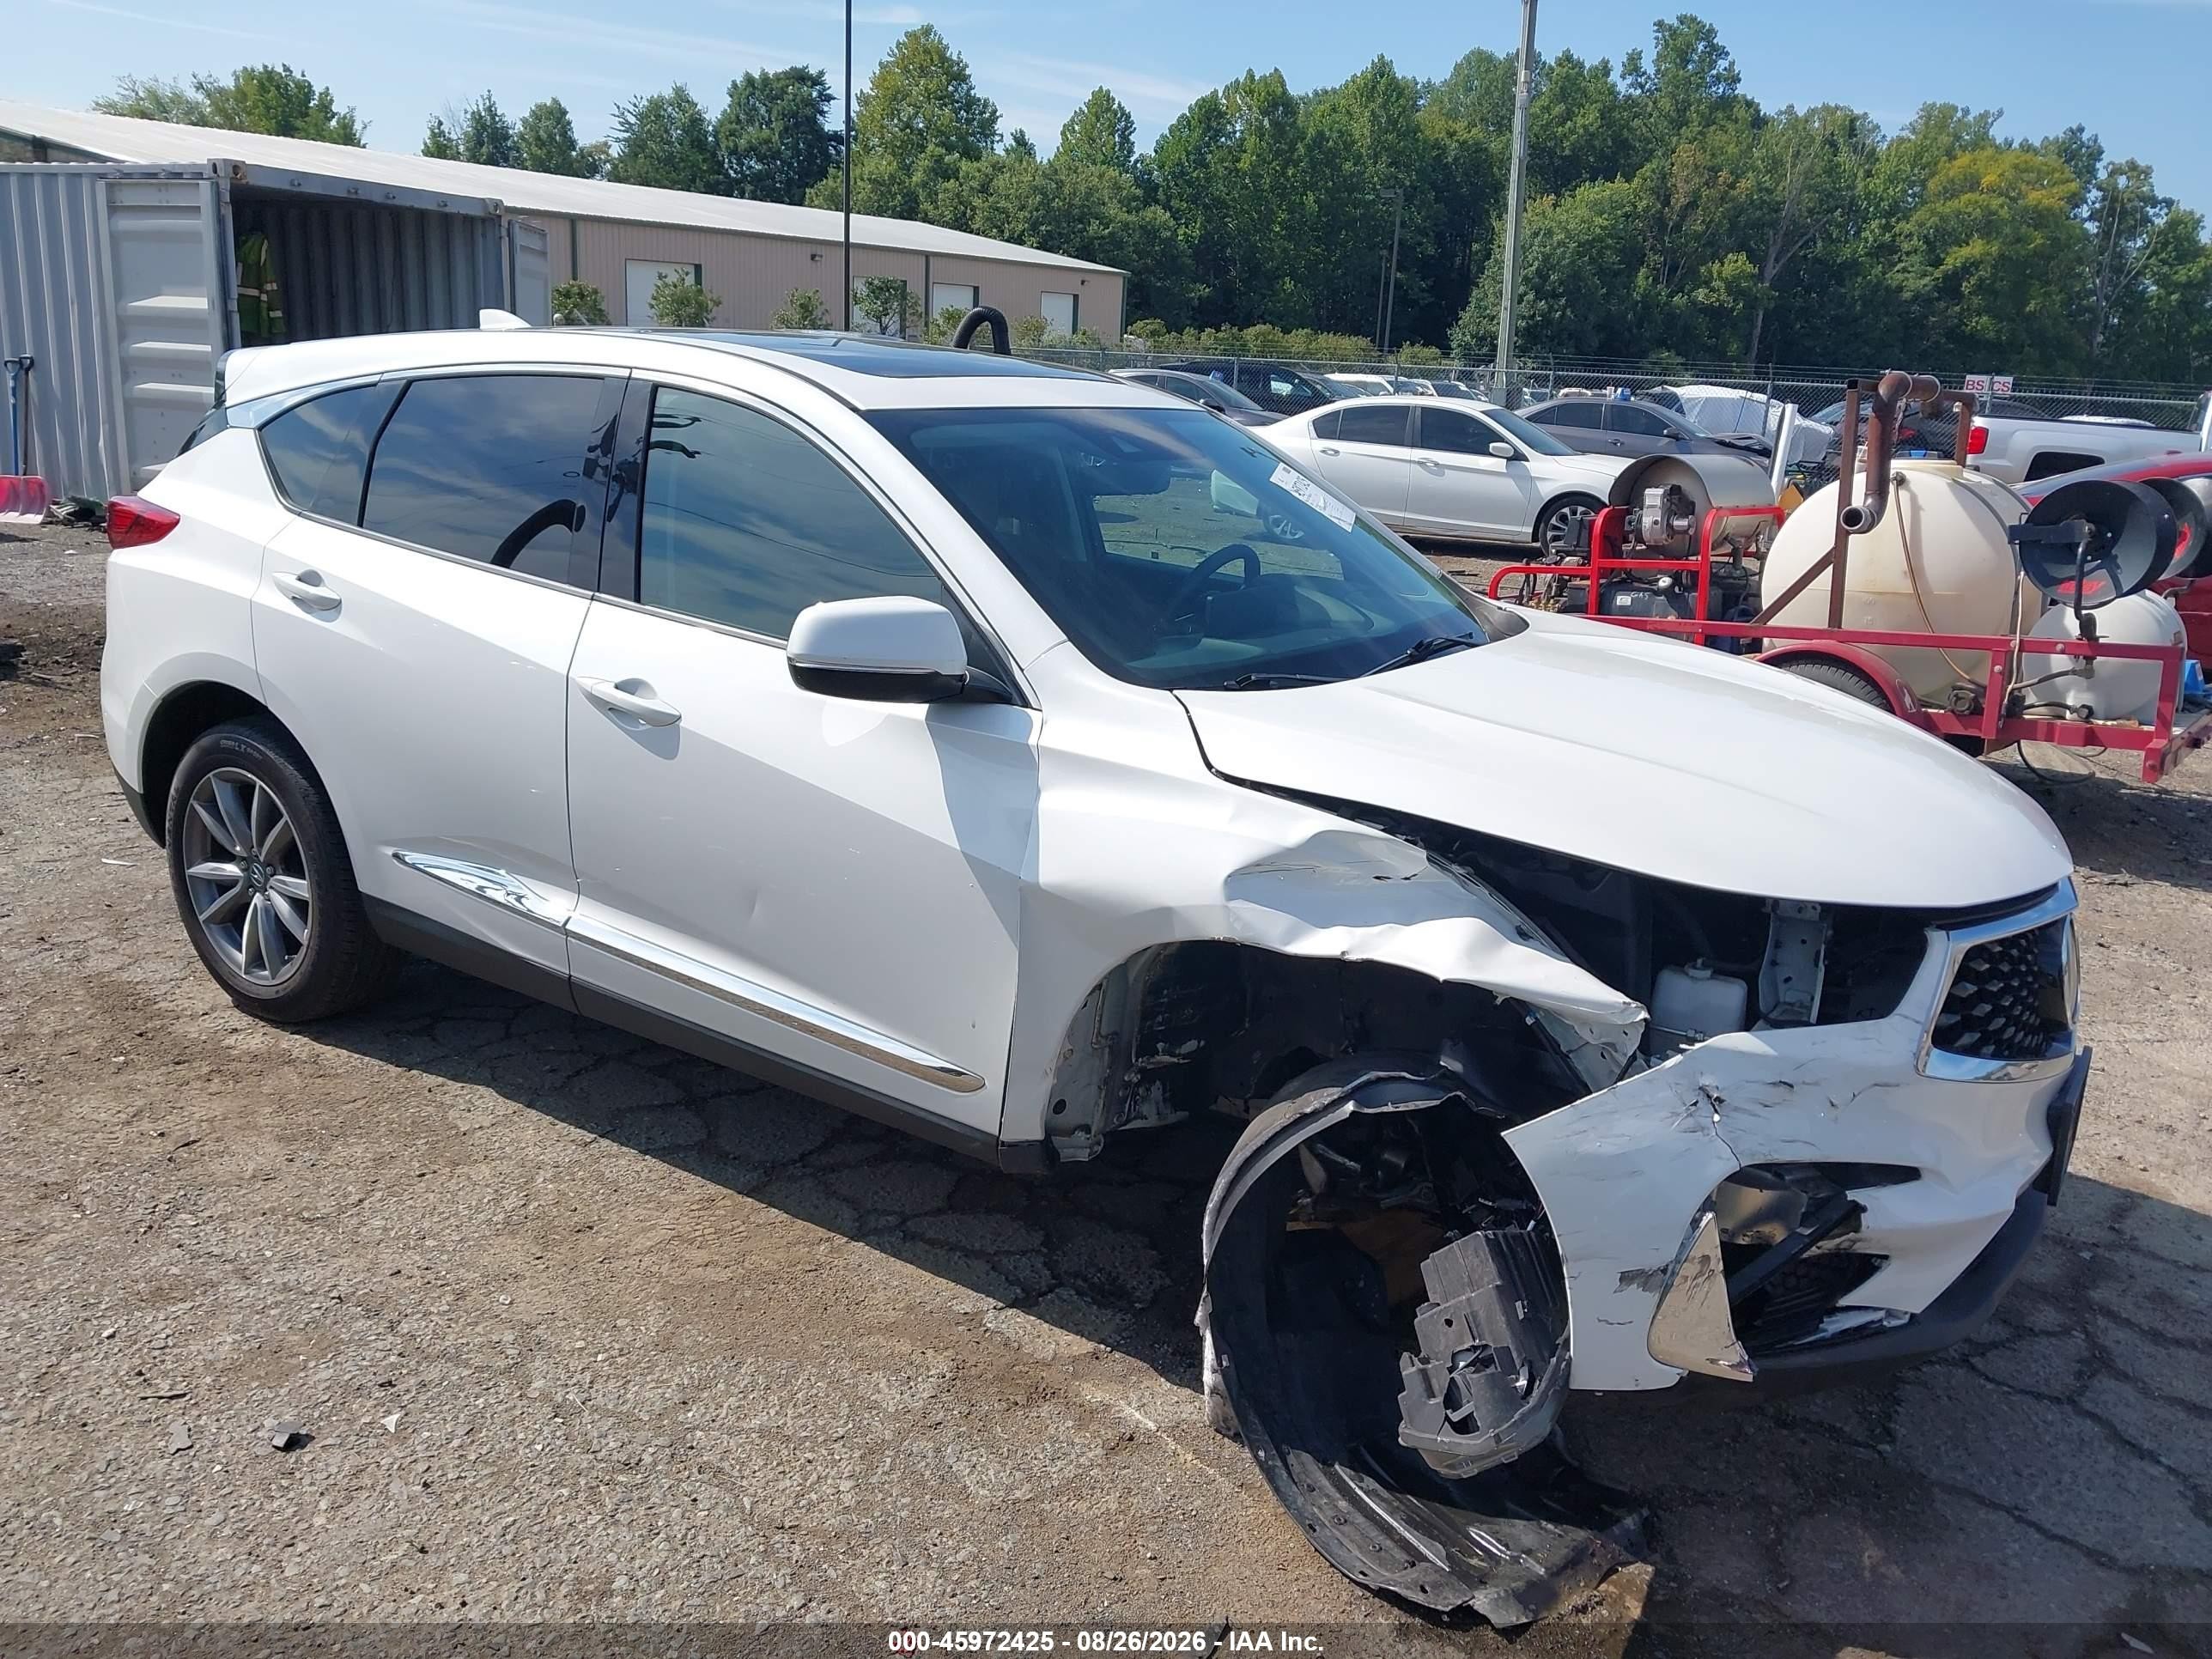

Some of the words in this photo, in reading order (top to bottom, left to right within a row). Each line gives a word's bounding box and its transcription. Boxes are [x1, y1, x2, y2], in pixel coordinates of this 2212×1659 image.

[1966, 380, 1984, 391] BS
[1992, 380, 2010, 392] CS
[1631, 591, 1650, 600] GAS
